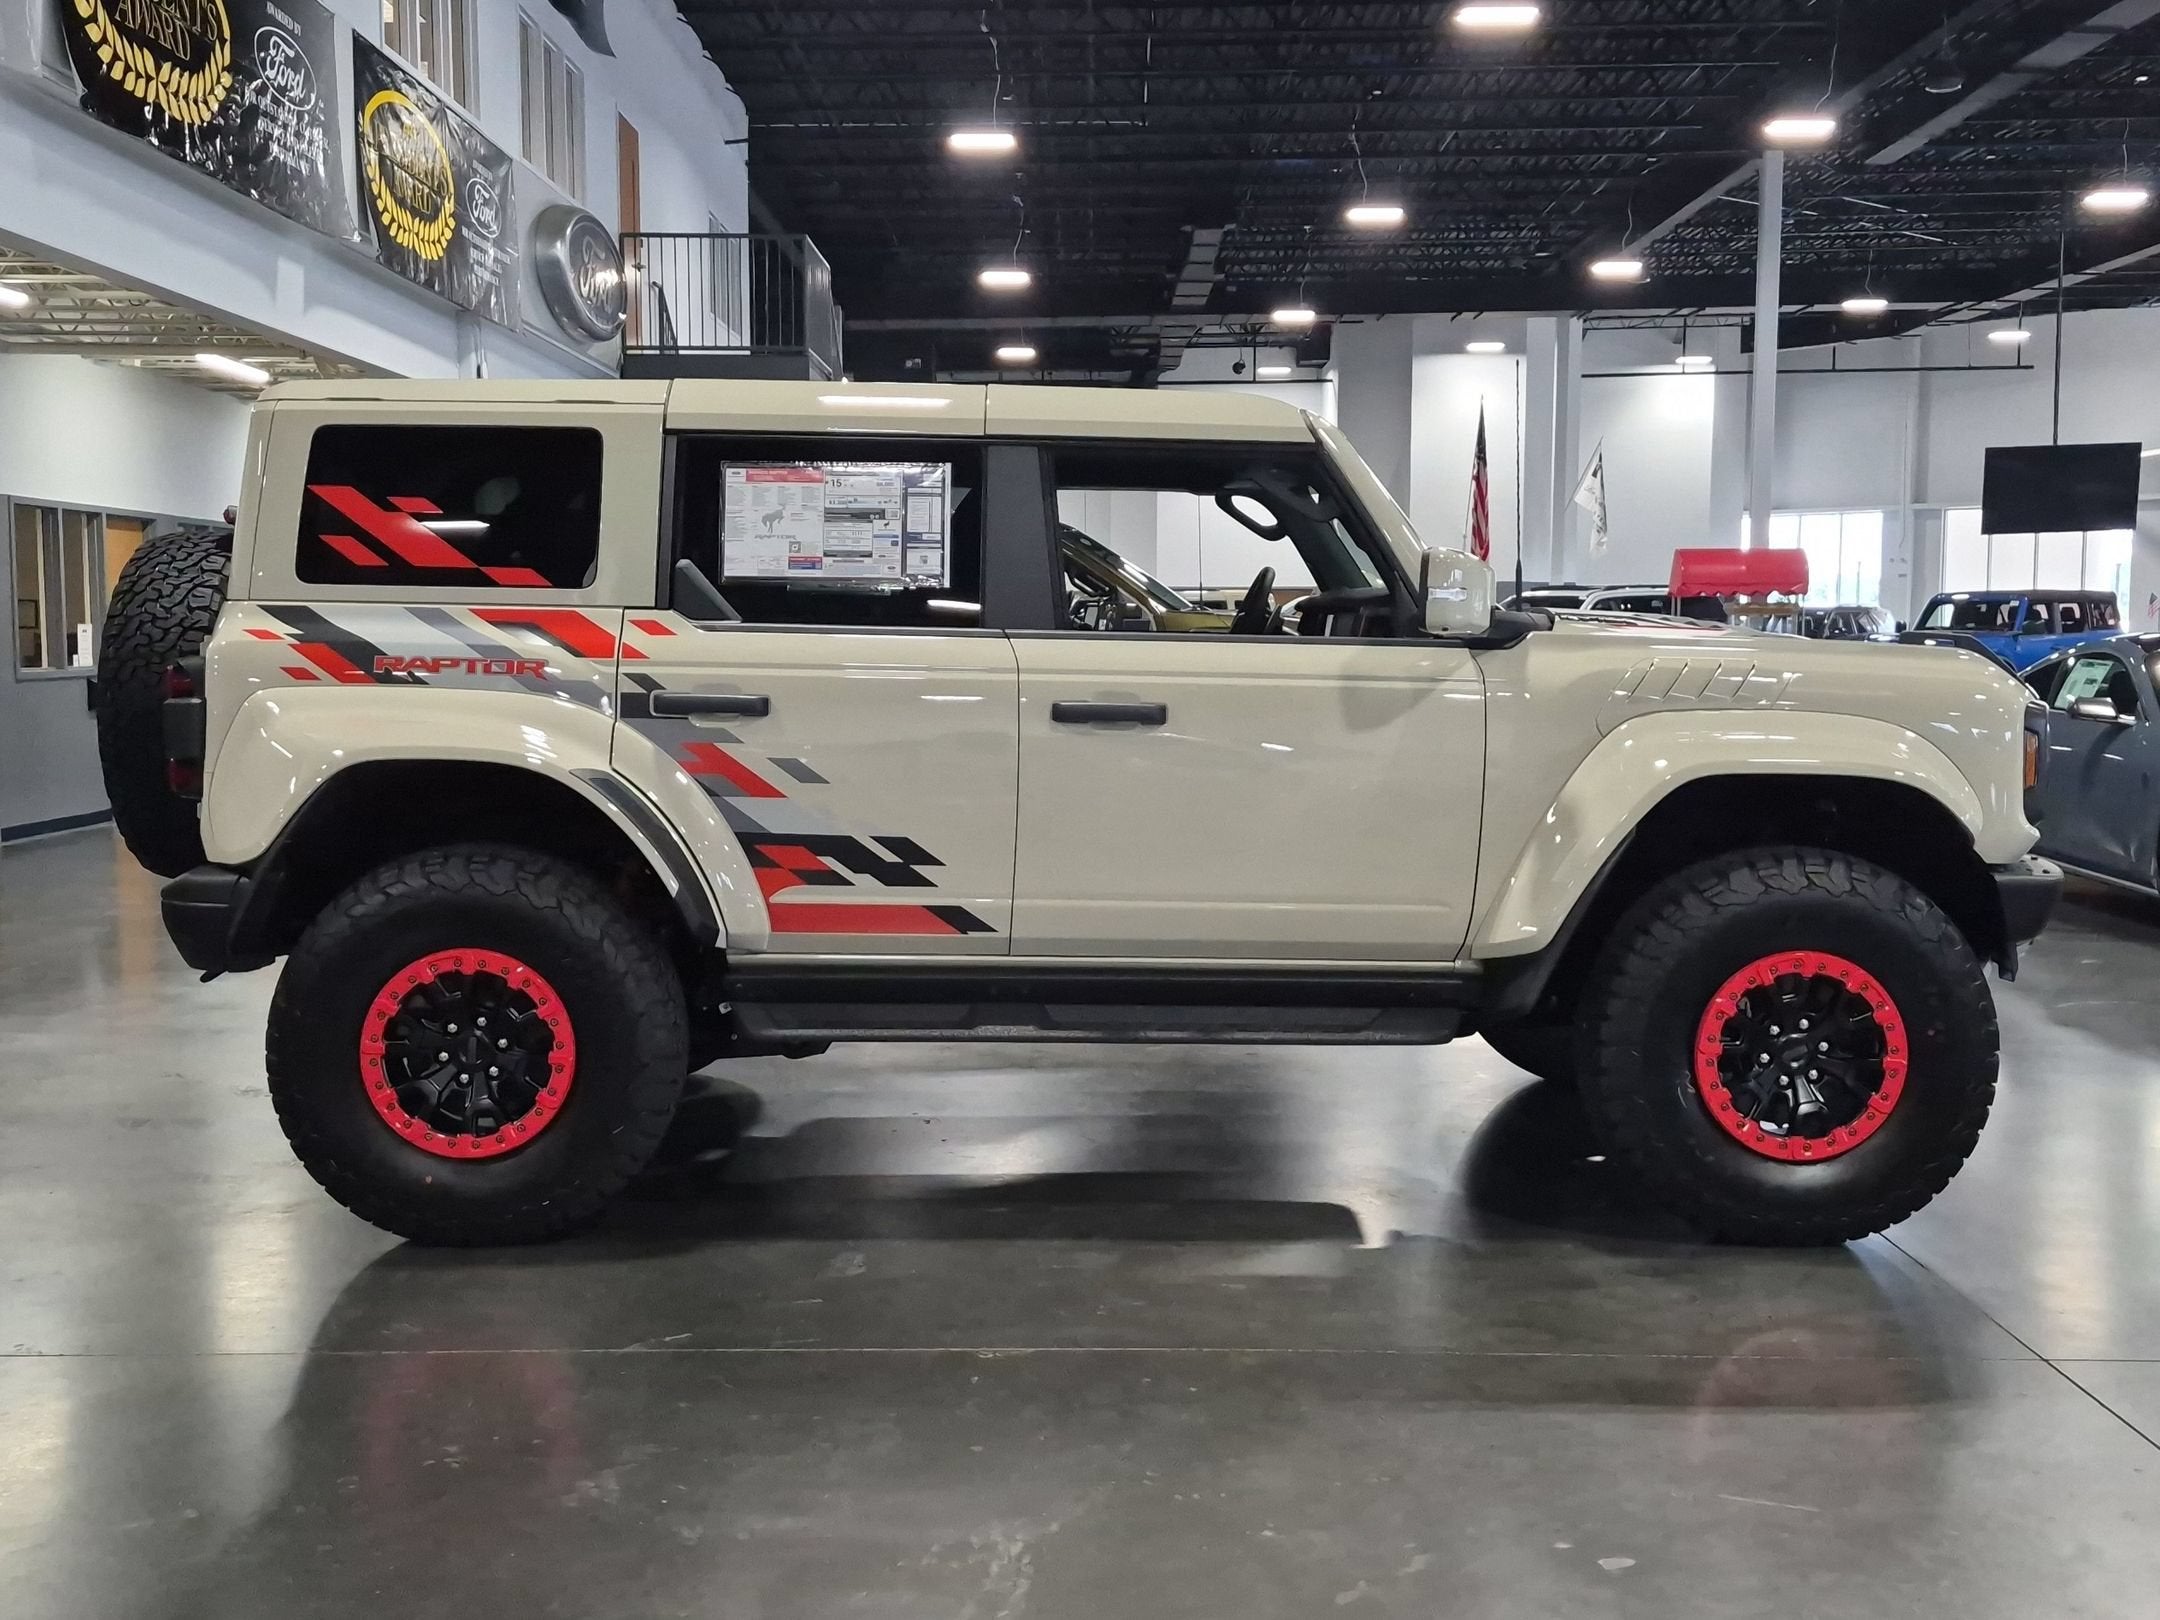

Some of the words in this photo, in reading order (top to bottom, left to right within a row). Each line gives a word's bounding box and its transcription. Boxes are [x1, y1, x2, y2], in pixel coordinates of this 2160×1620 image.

[115, 0, 190, 61] AWARD
[265, 35, 306, 98] Ford
[472, 184, 497, 226] Ford
[831, 479, 842, 487] 15
[374, 655, 549, 681] RAPTOR
